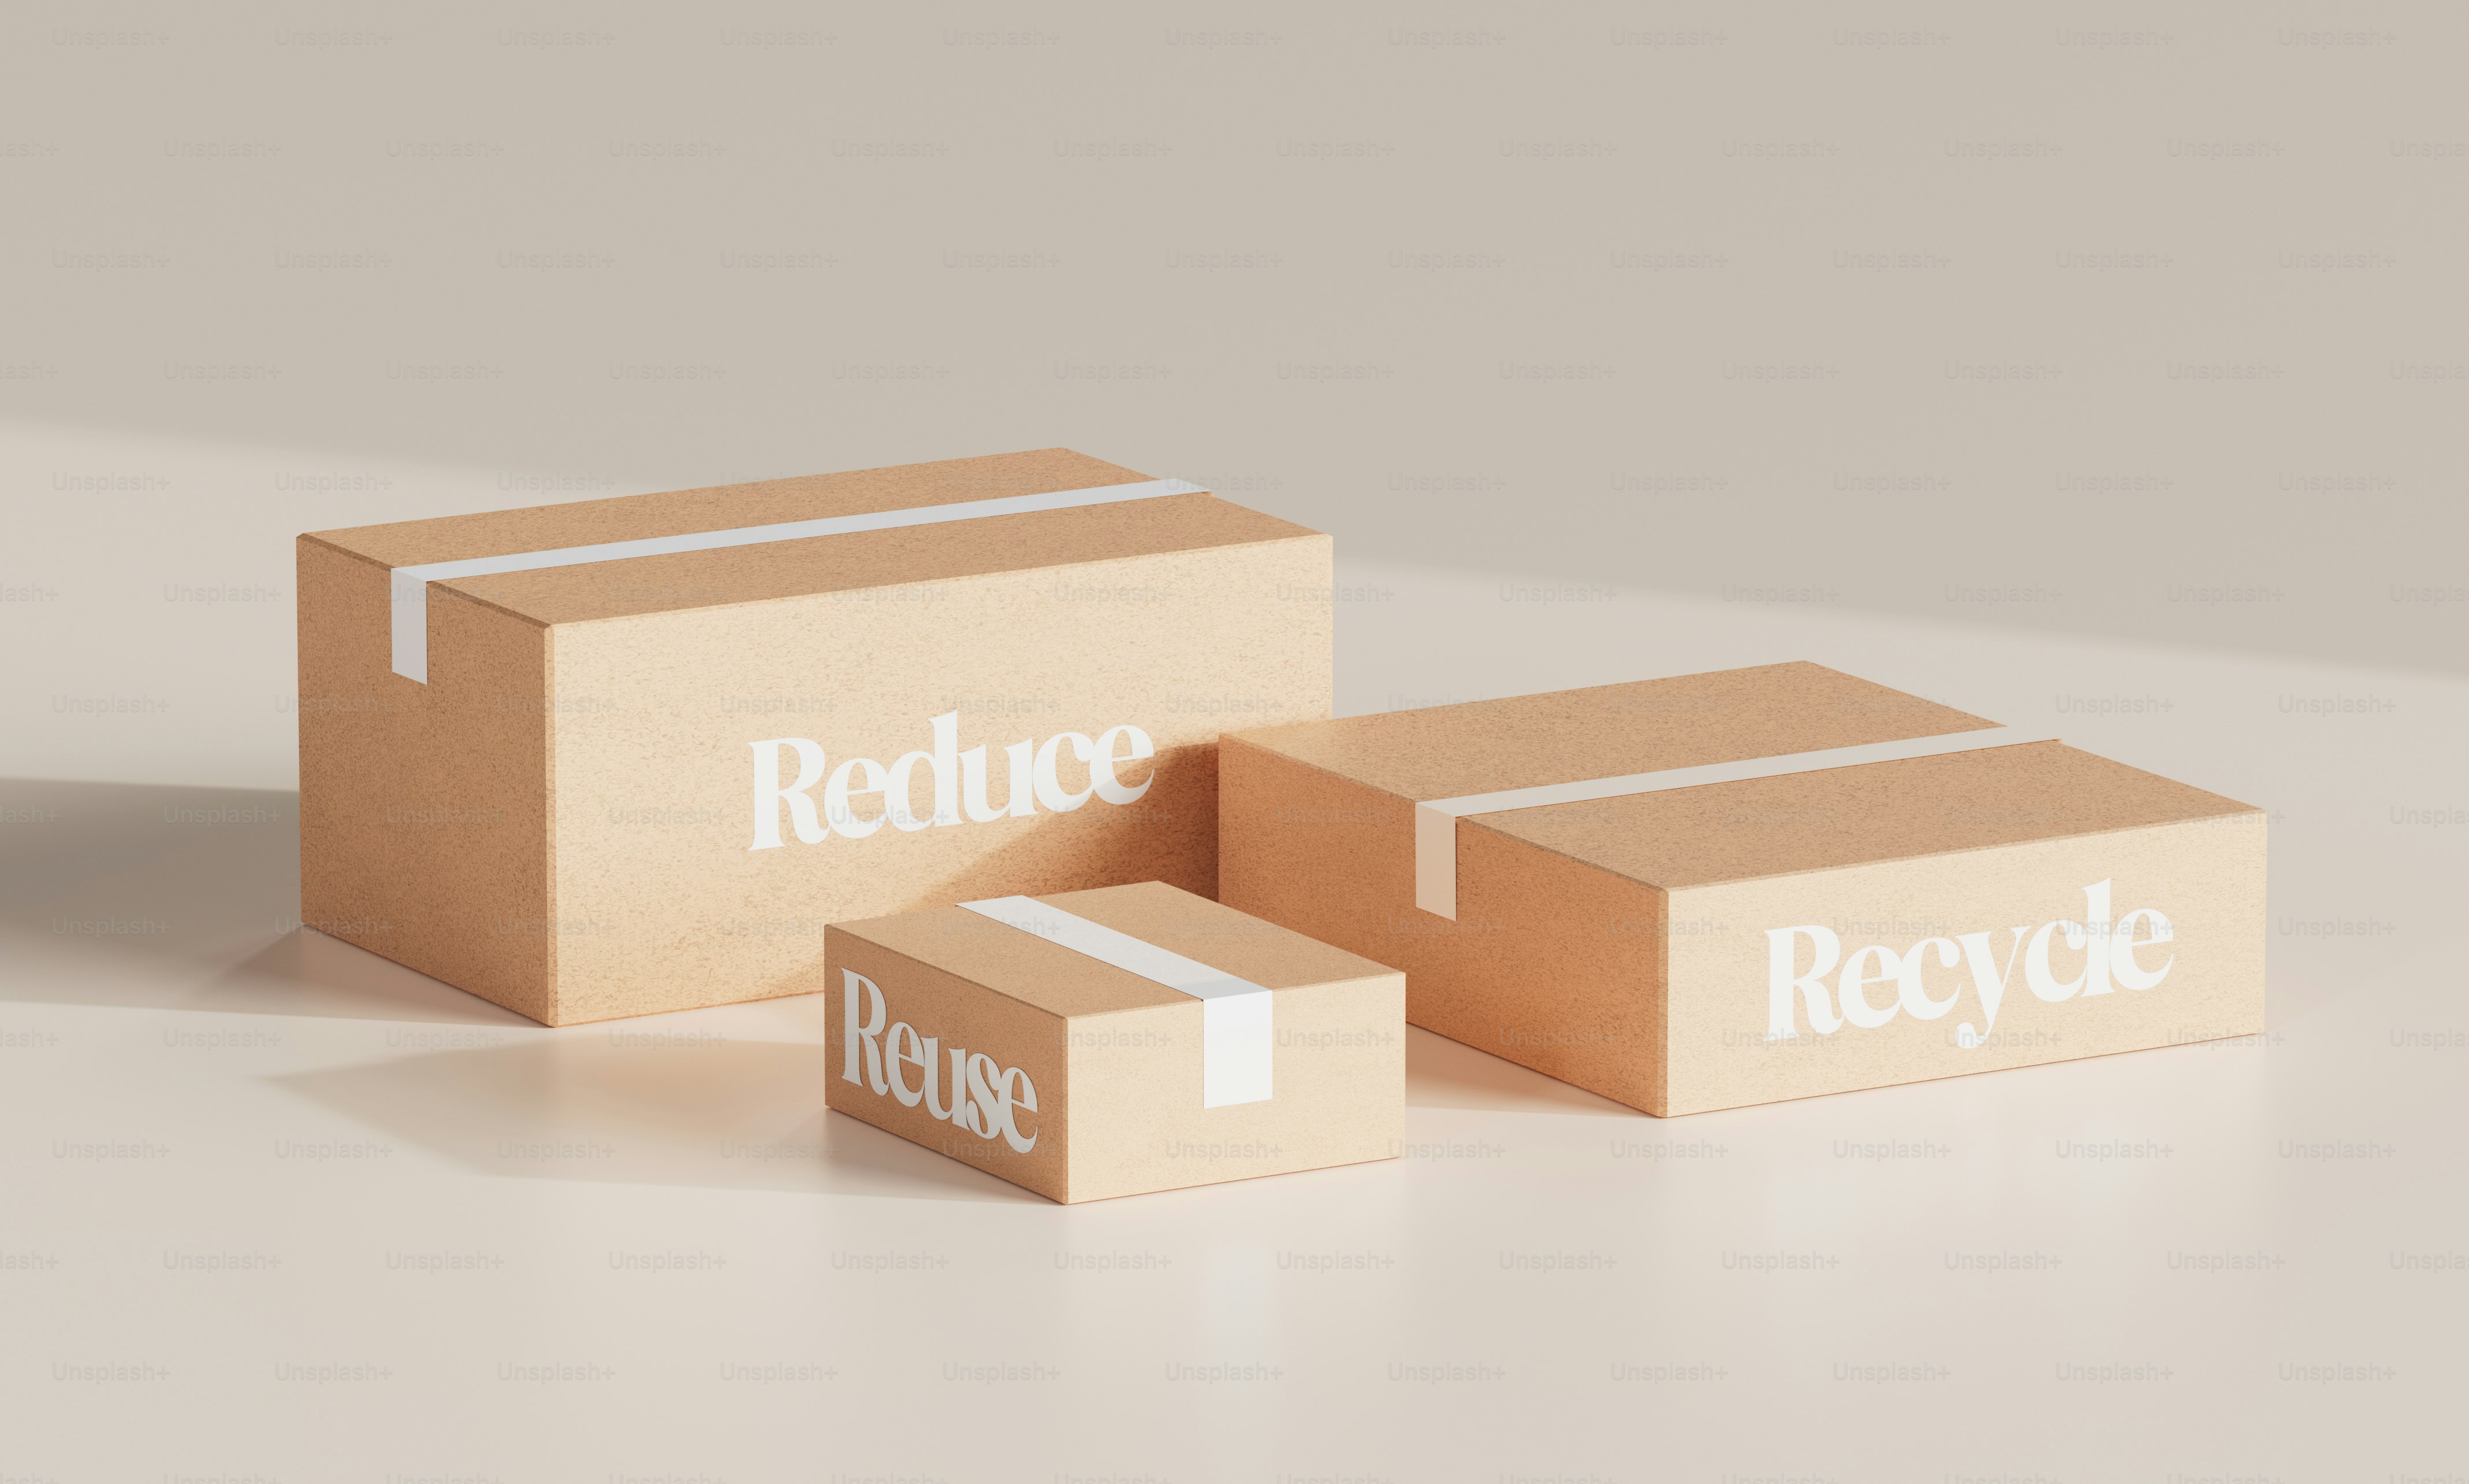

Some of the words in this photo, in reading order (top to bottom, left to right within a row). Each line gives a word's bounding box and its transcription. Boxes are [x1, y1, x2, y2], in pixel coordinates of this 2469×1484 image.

[747, 708, 1155, 852] Reduce
[1763, 878, 2175, 1049] Recycle
[841, 968, 1038, 1153] Reuse
